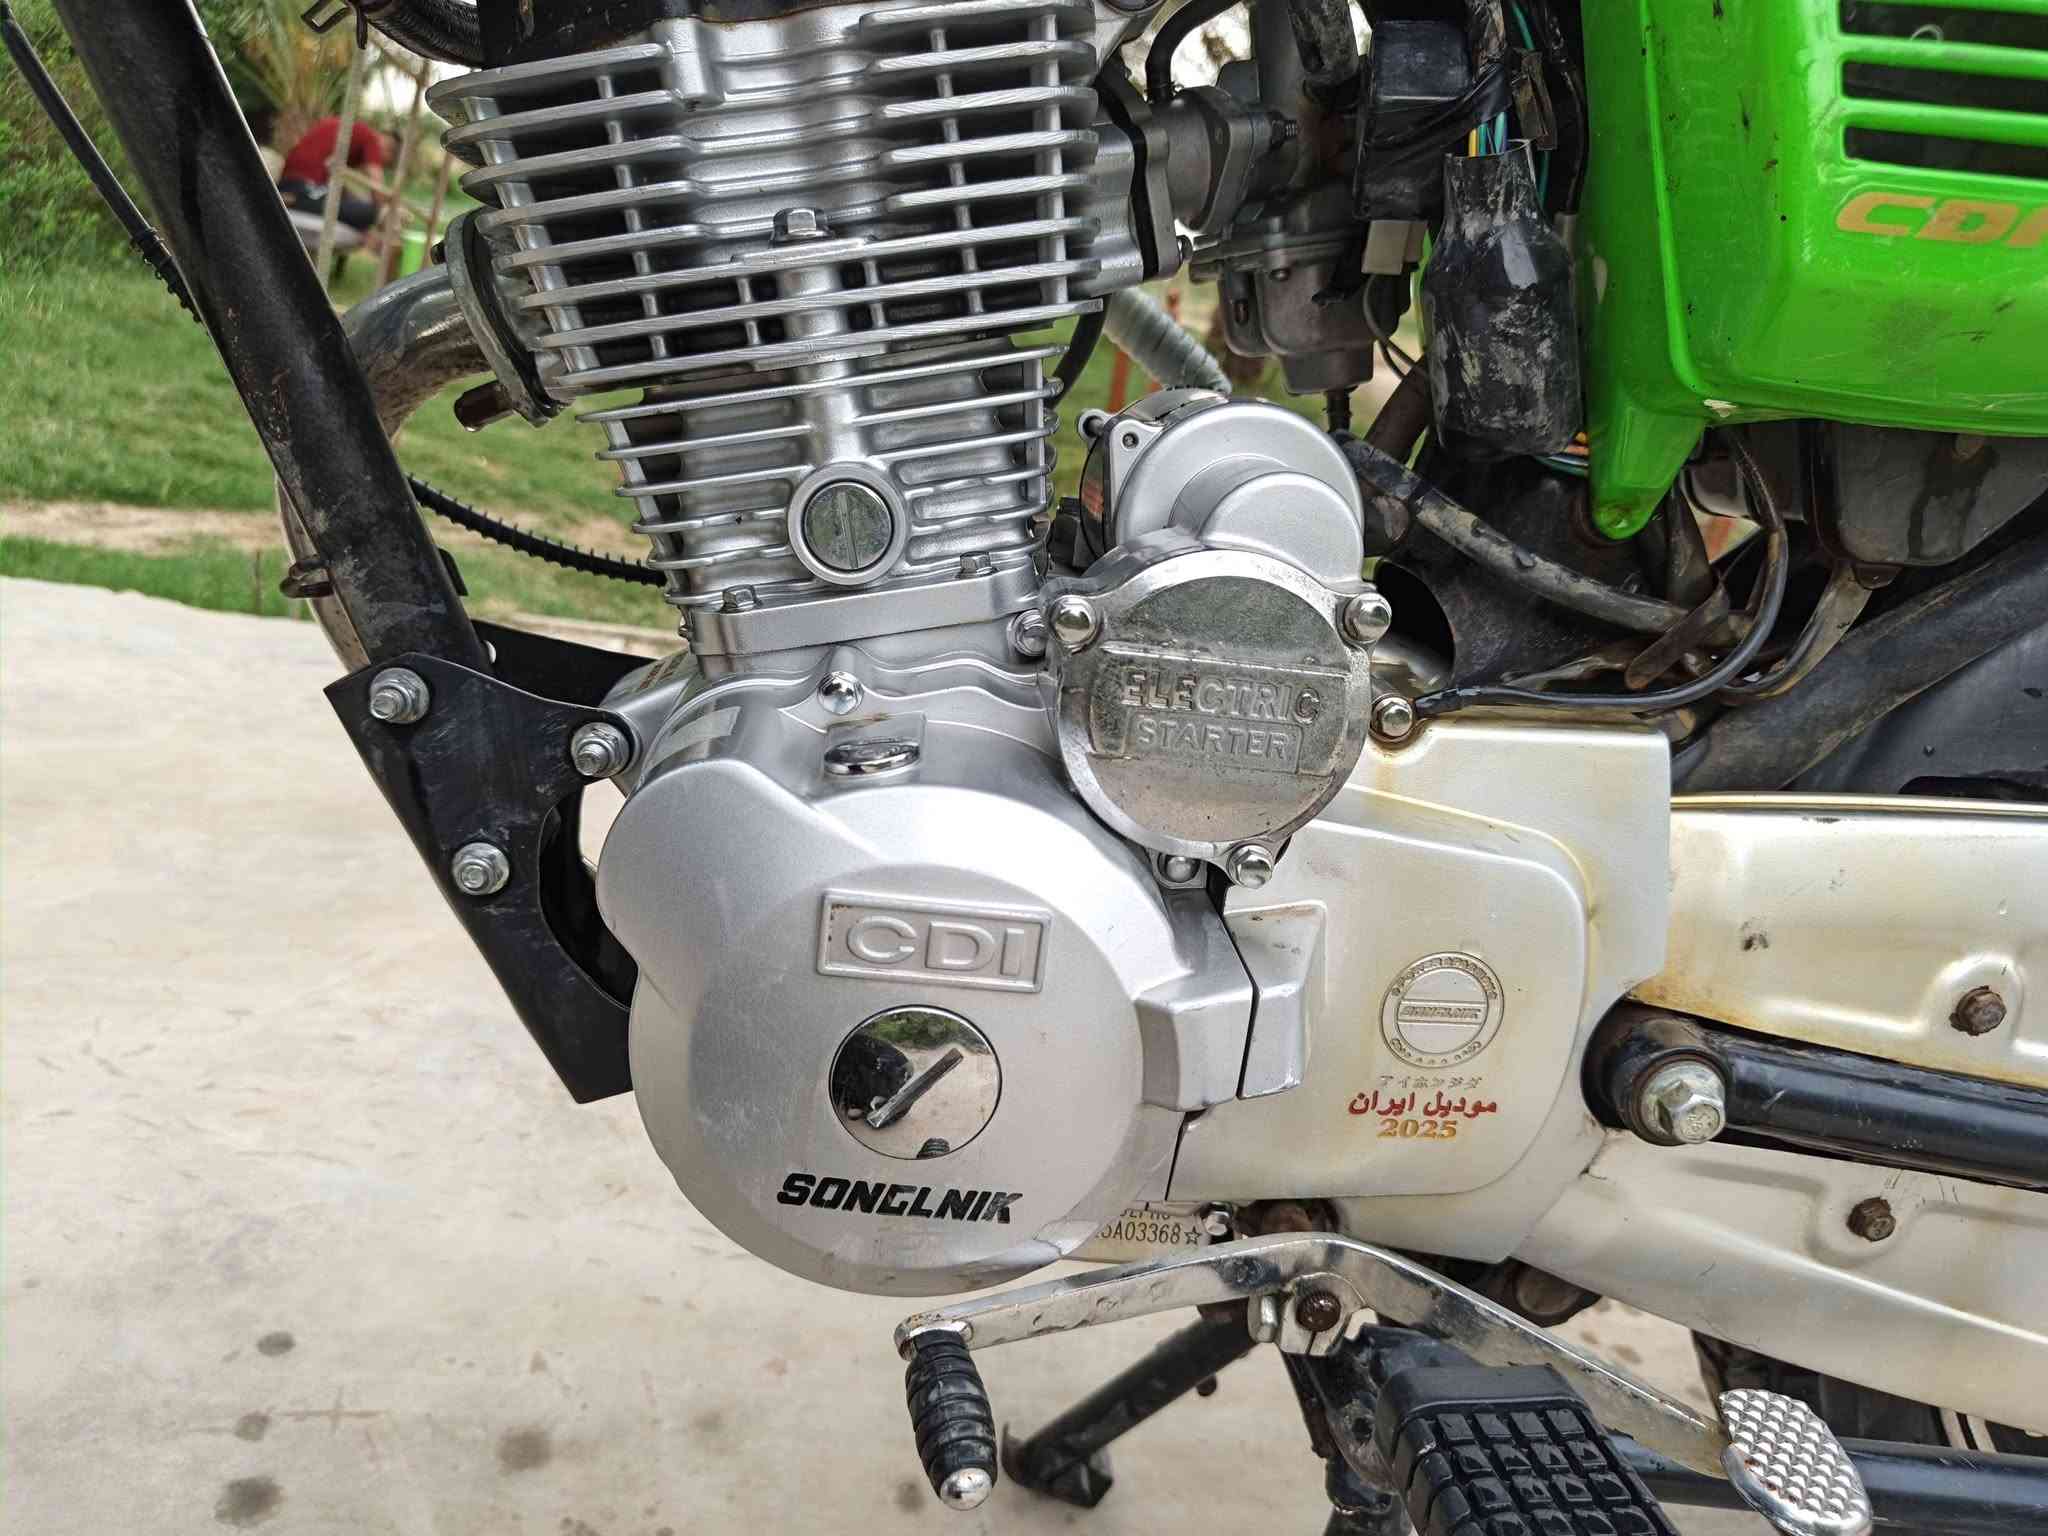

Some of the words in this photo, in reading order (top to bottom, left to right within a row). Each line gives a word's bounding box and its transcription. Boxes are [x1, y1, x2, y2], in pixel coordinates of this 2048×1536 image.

[1119, 666, 1321, 724] ELECTRIC
[1136, 716, 1292, 761] STARTER
[847, 914, 1026, 977] CDI
[1377, 1118, 1458, 1139] 2025
